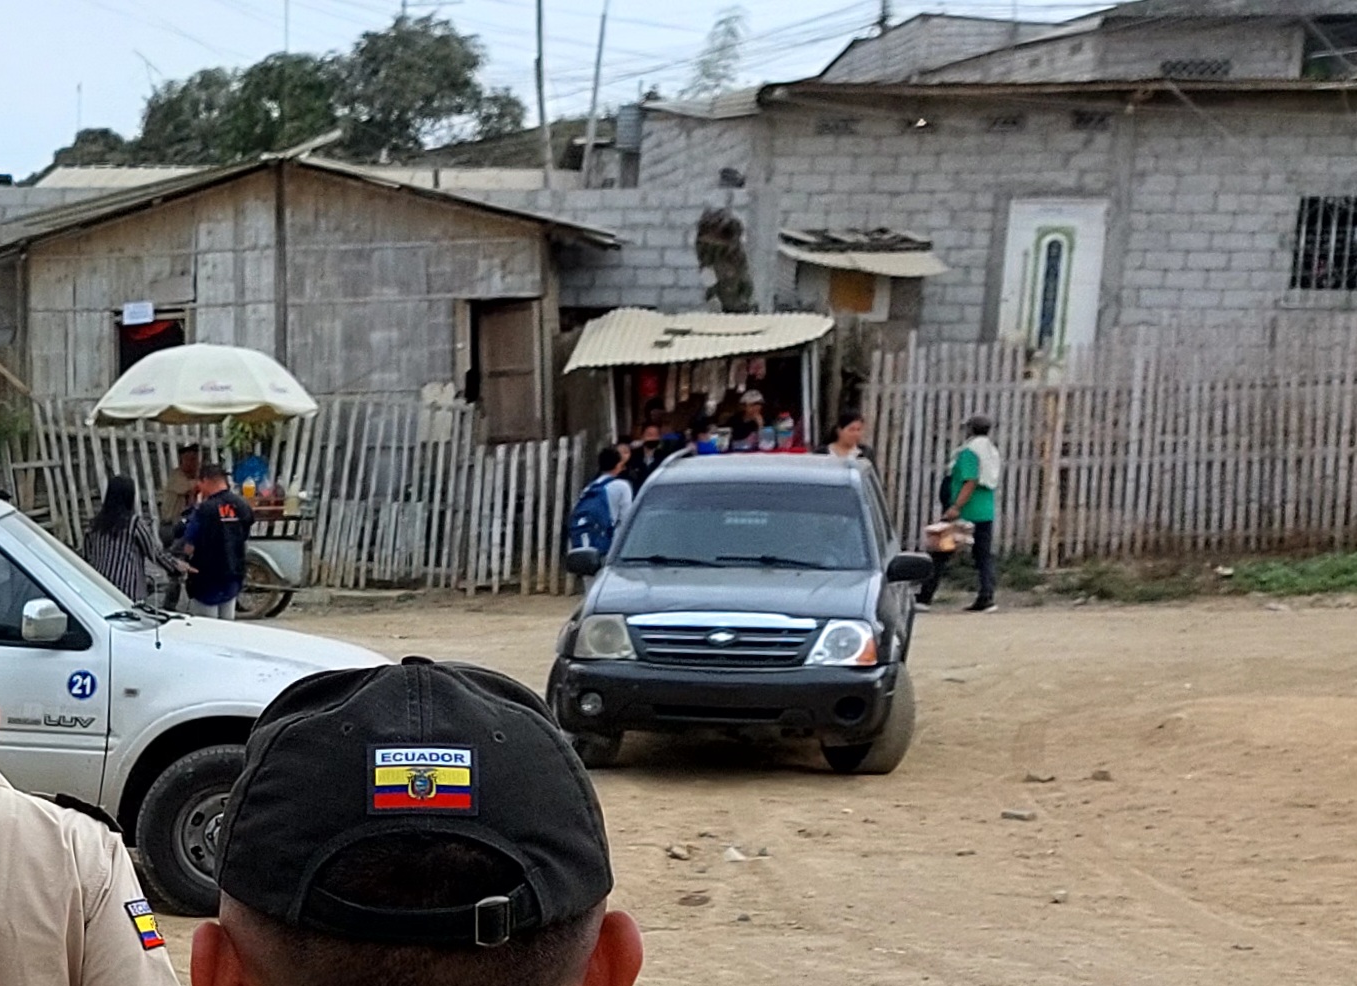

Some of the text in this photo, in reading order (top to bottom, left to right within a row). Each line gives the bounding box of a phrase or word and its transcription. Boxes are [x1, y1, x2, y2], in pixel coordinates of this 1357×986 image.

[71, 674, 92, 695] 21
[43, 714, 96, 728] LUV
[380, 751, 466, 763] ECUADOR
